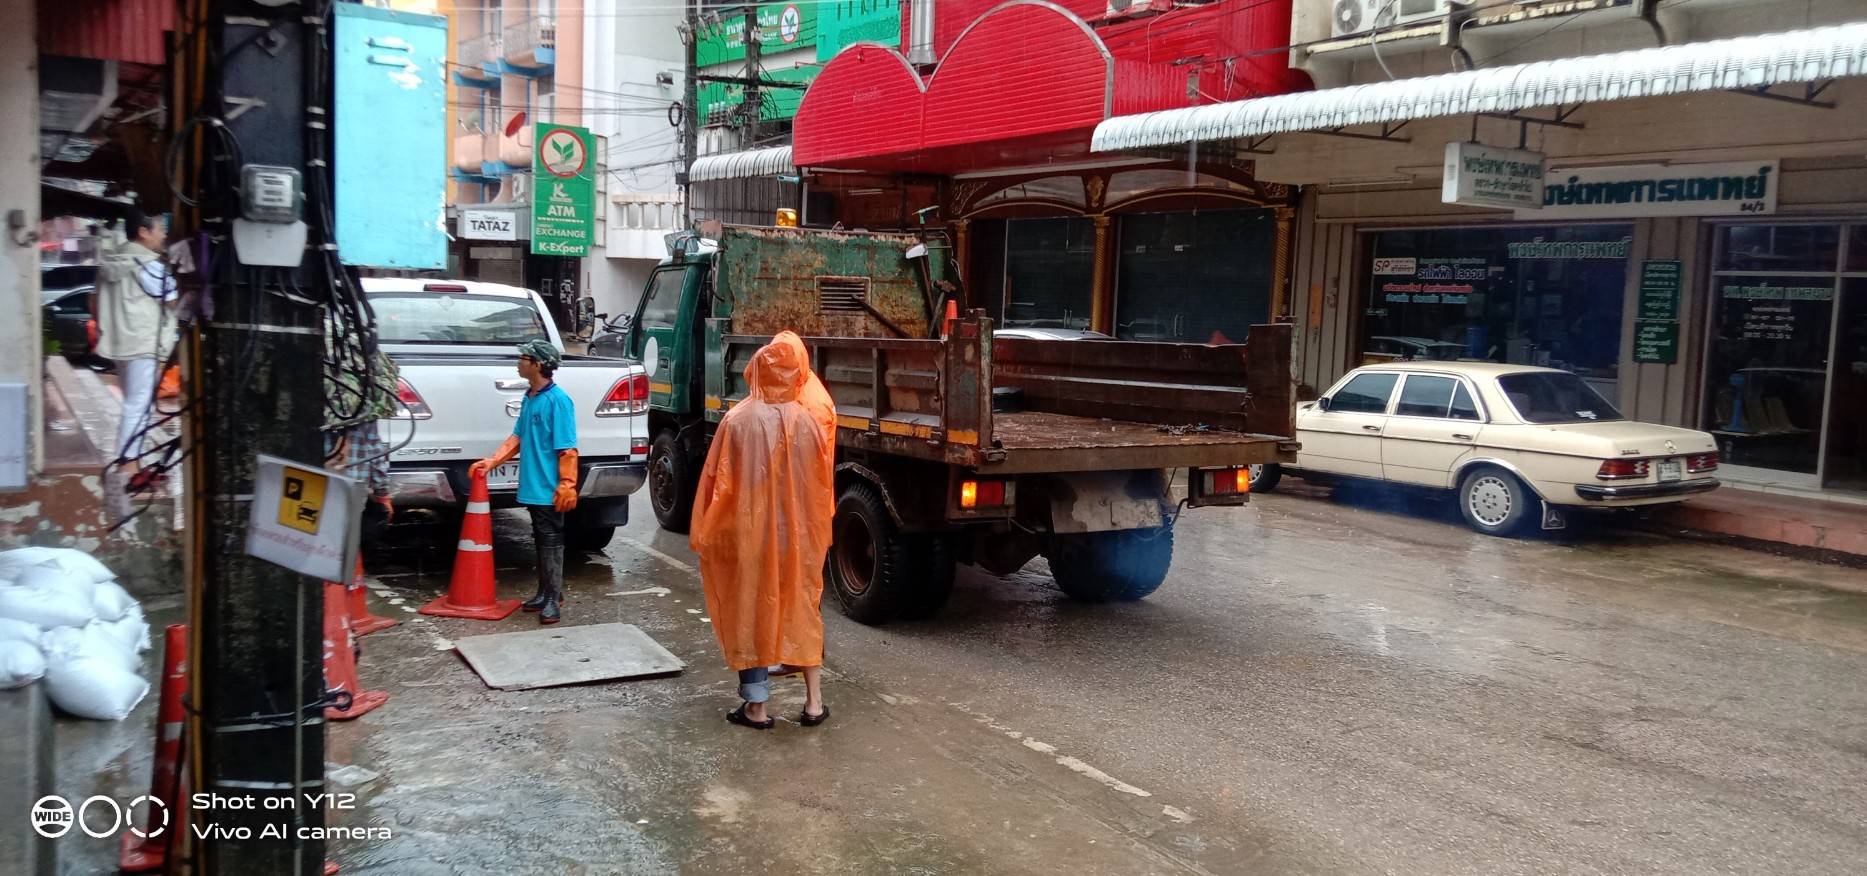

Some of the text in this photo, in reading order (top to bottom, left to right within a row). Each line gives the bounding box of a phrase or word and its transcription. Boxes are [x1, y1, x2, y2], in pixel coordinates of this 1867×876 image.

[1544, 166, 1772, 206] งษ์เทพการแพทย์
[547, 204, 576, 218] ATM
[470, 219, 510, 232] TATAZ
[536, 227, 587, 239] EXCHANGE
[1375, 260, 1390, 272] SP
